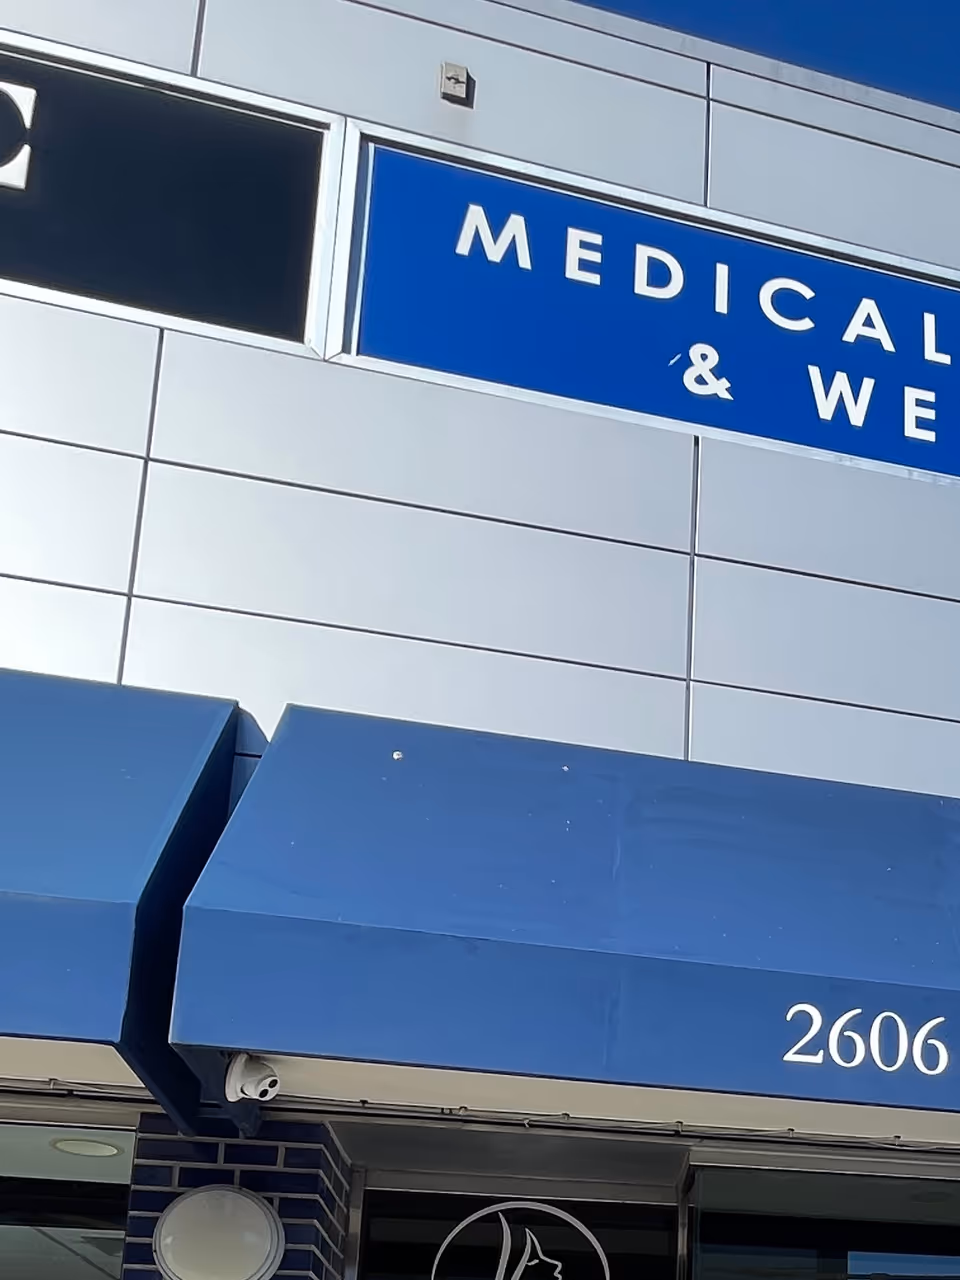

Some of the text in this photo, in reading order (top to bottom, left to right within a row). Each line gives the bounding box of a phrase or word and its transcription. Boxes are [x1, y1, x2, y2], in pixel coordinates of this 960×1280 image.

[455, 203, 952, 366] MEDICAL
[682, 343, 733, 401] &
[782, 1003, 950, 1075] 2606
